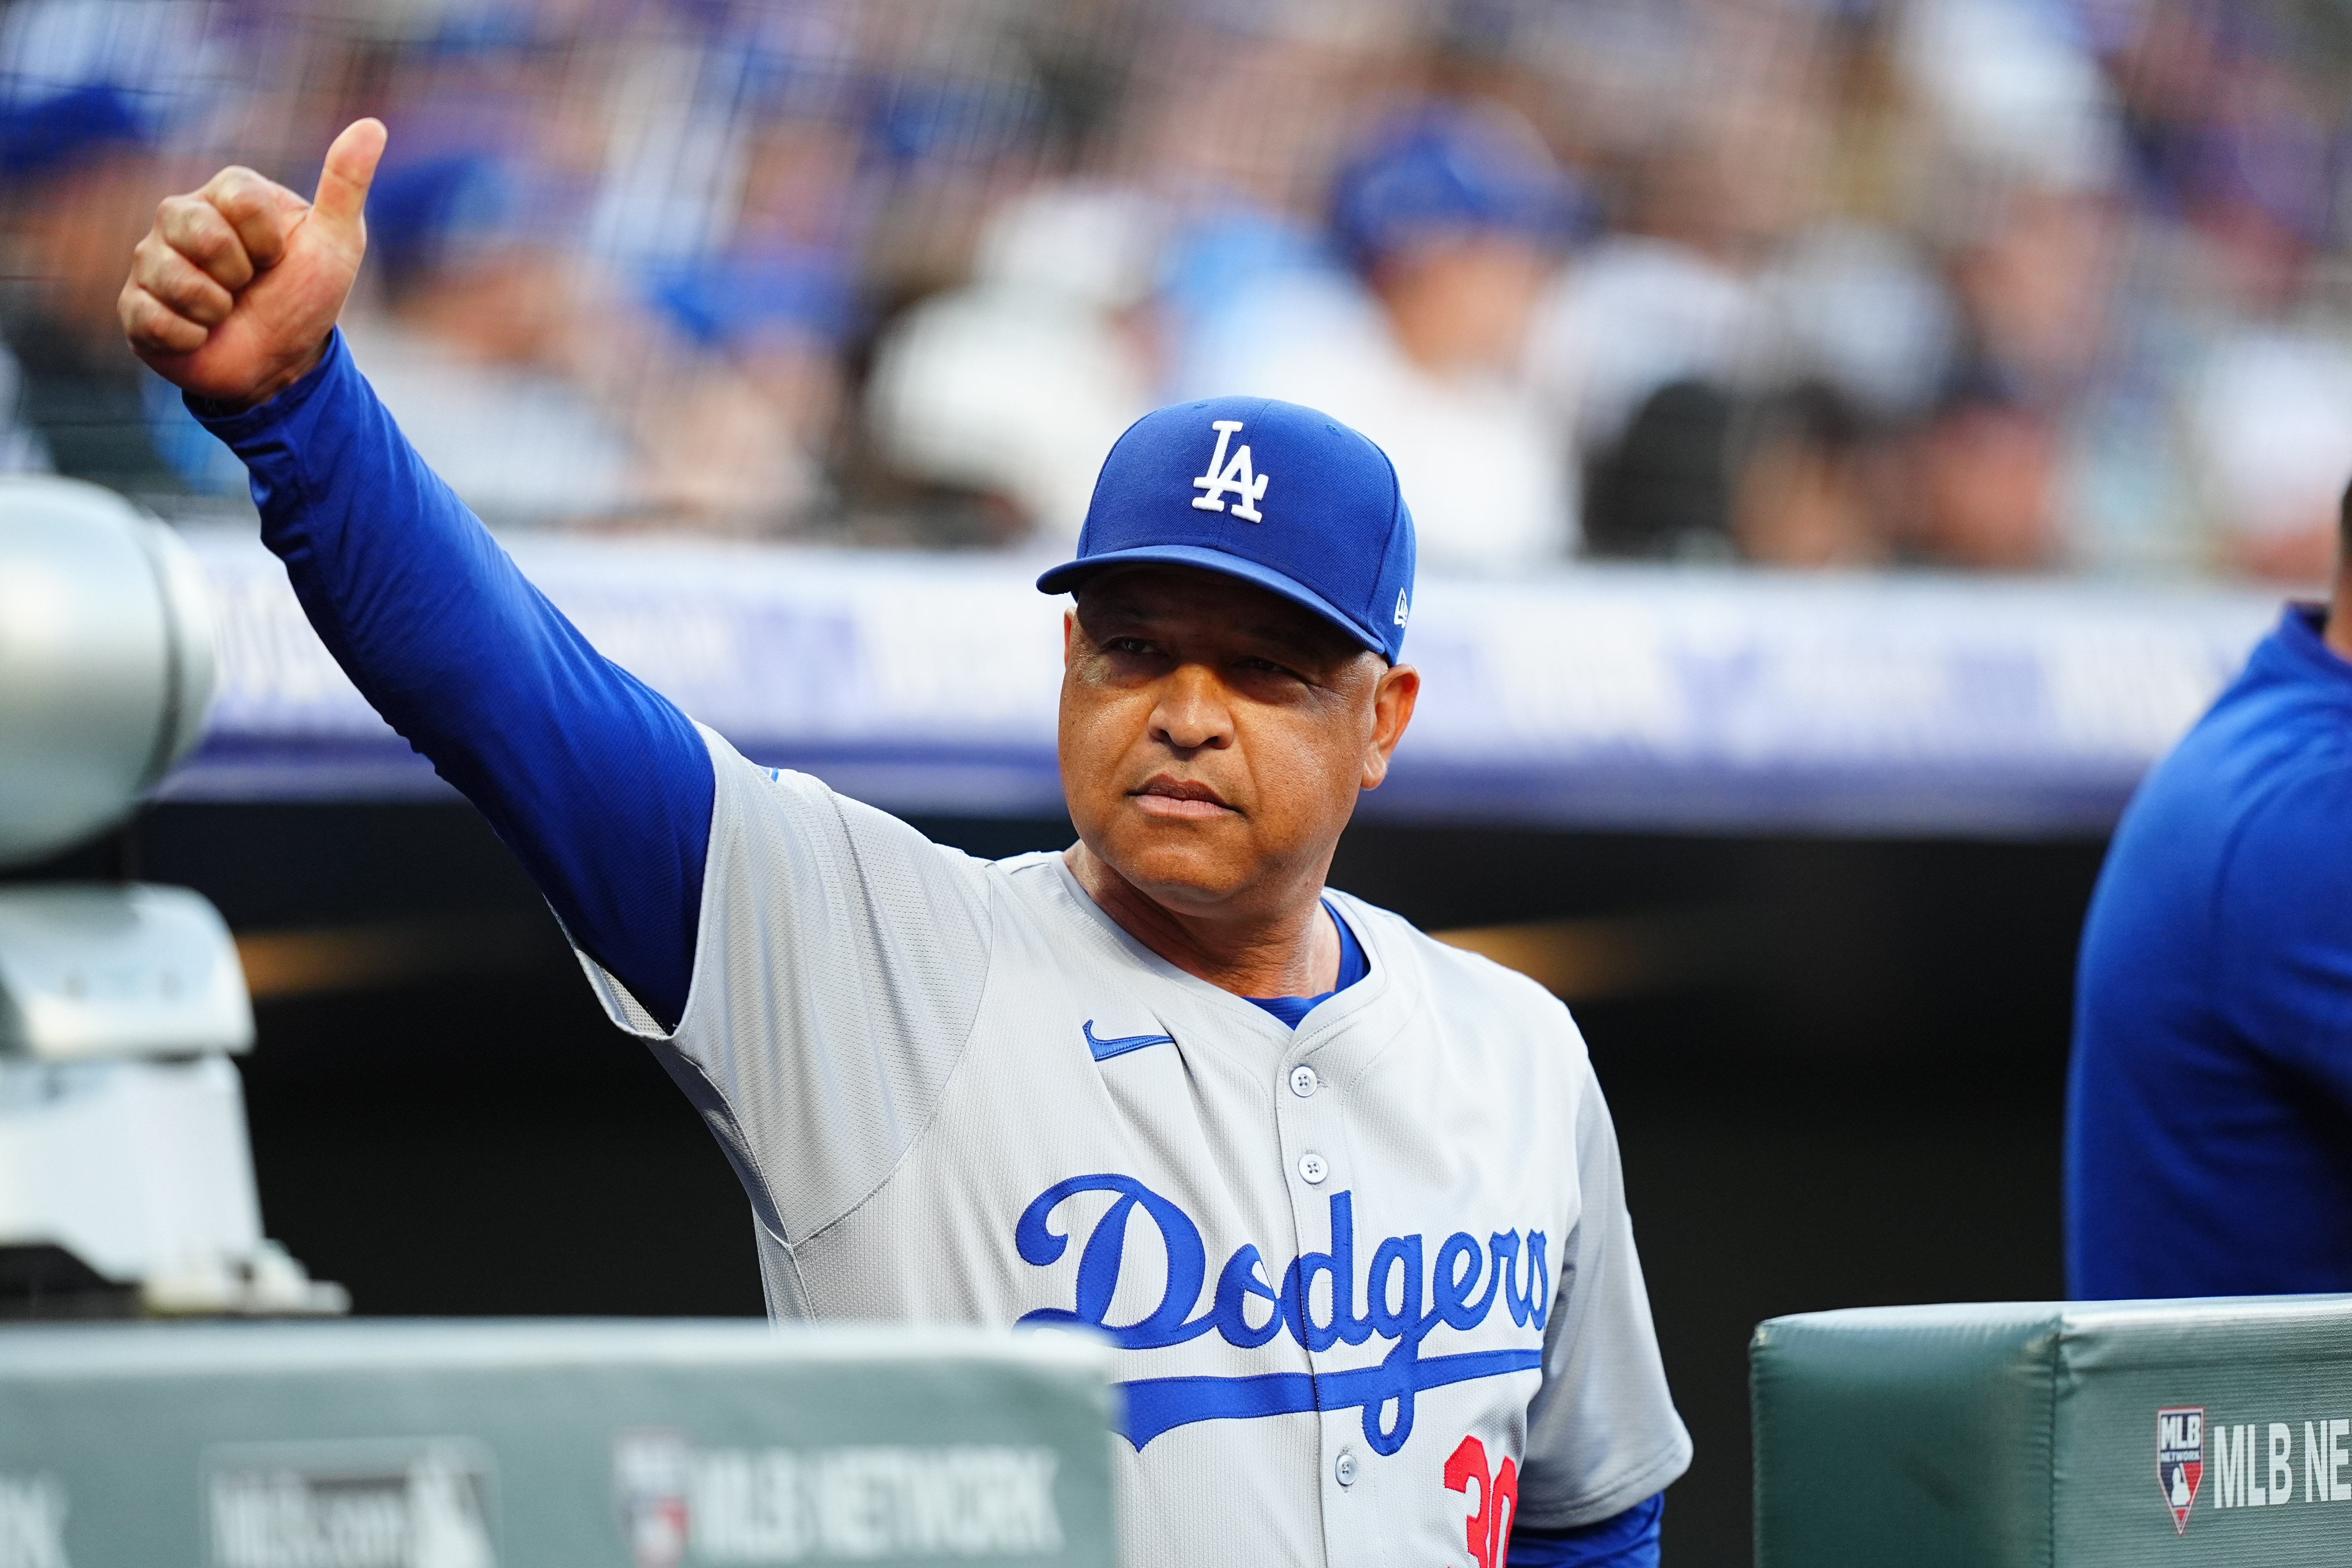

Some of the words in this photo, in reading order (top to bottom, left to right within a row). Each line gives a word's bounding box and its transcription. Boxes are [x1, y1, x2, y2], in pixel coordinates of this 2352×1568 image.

[1192, 421, 1269, 523] LA
[1012, 1174, 1547, 1455] Dodgers
[2161, 1415, 2201, 1450] MLB
[2214, 1423, 2293, 1509] MLB
[2305, 1419, 2352, 1503] NE
[1444, 1434, 1518, 1568] 30
